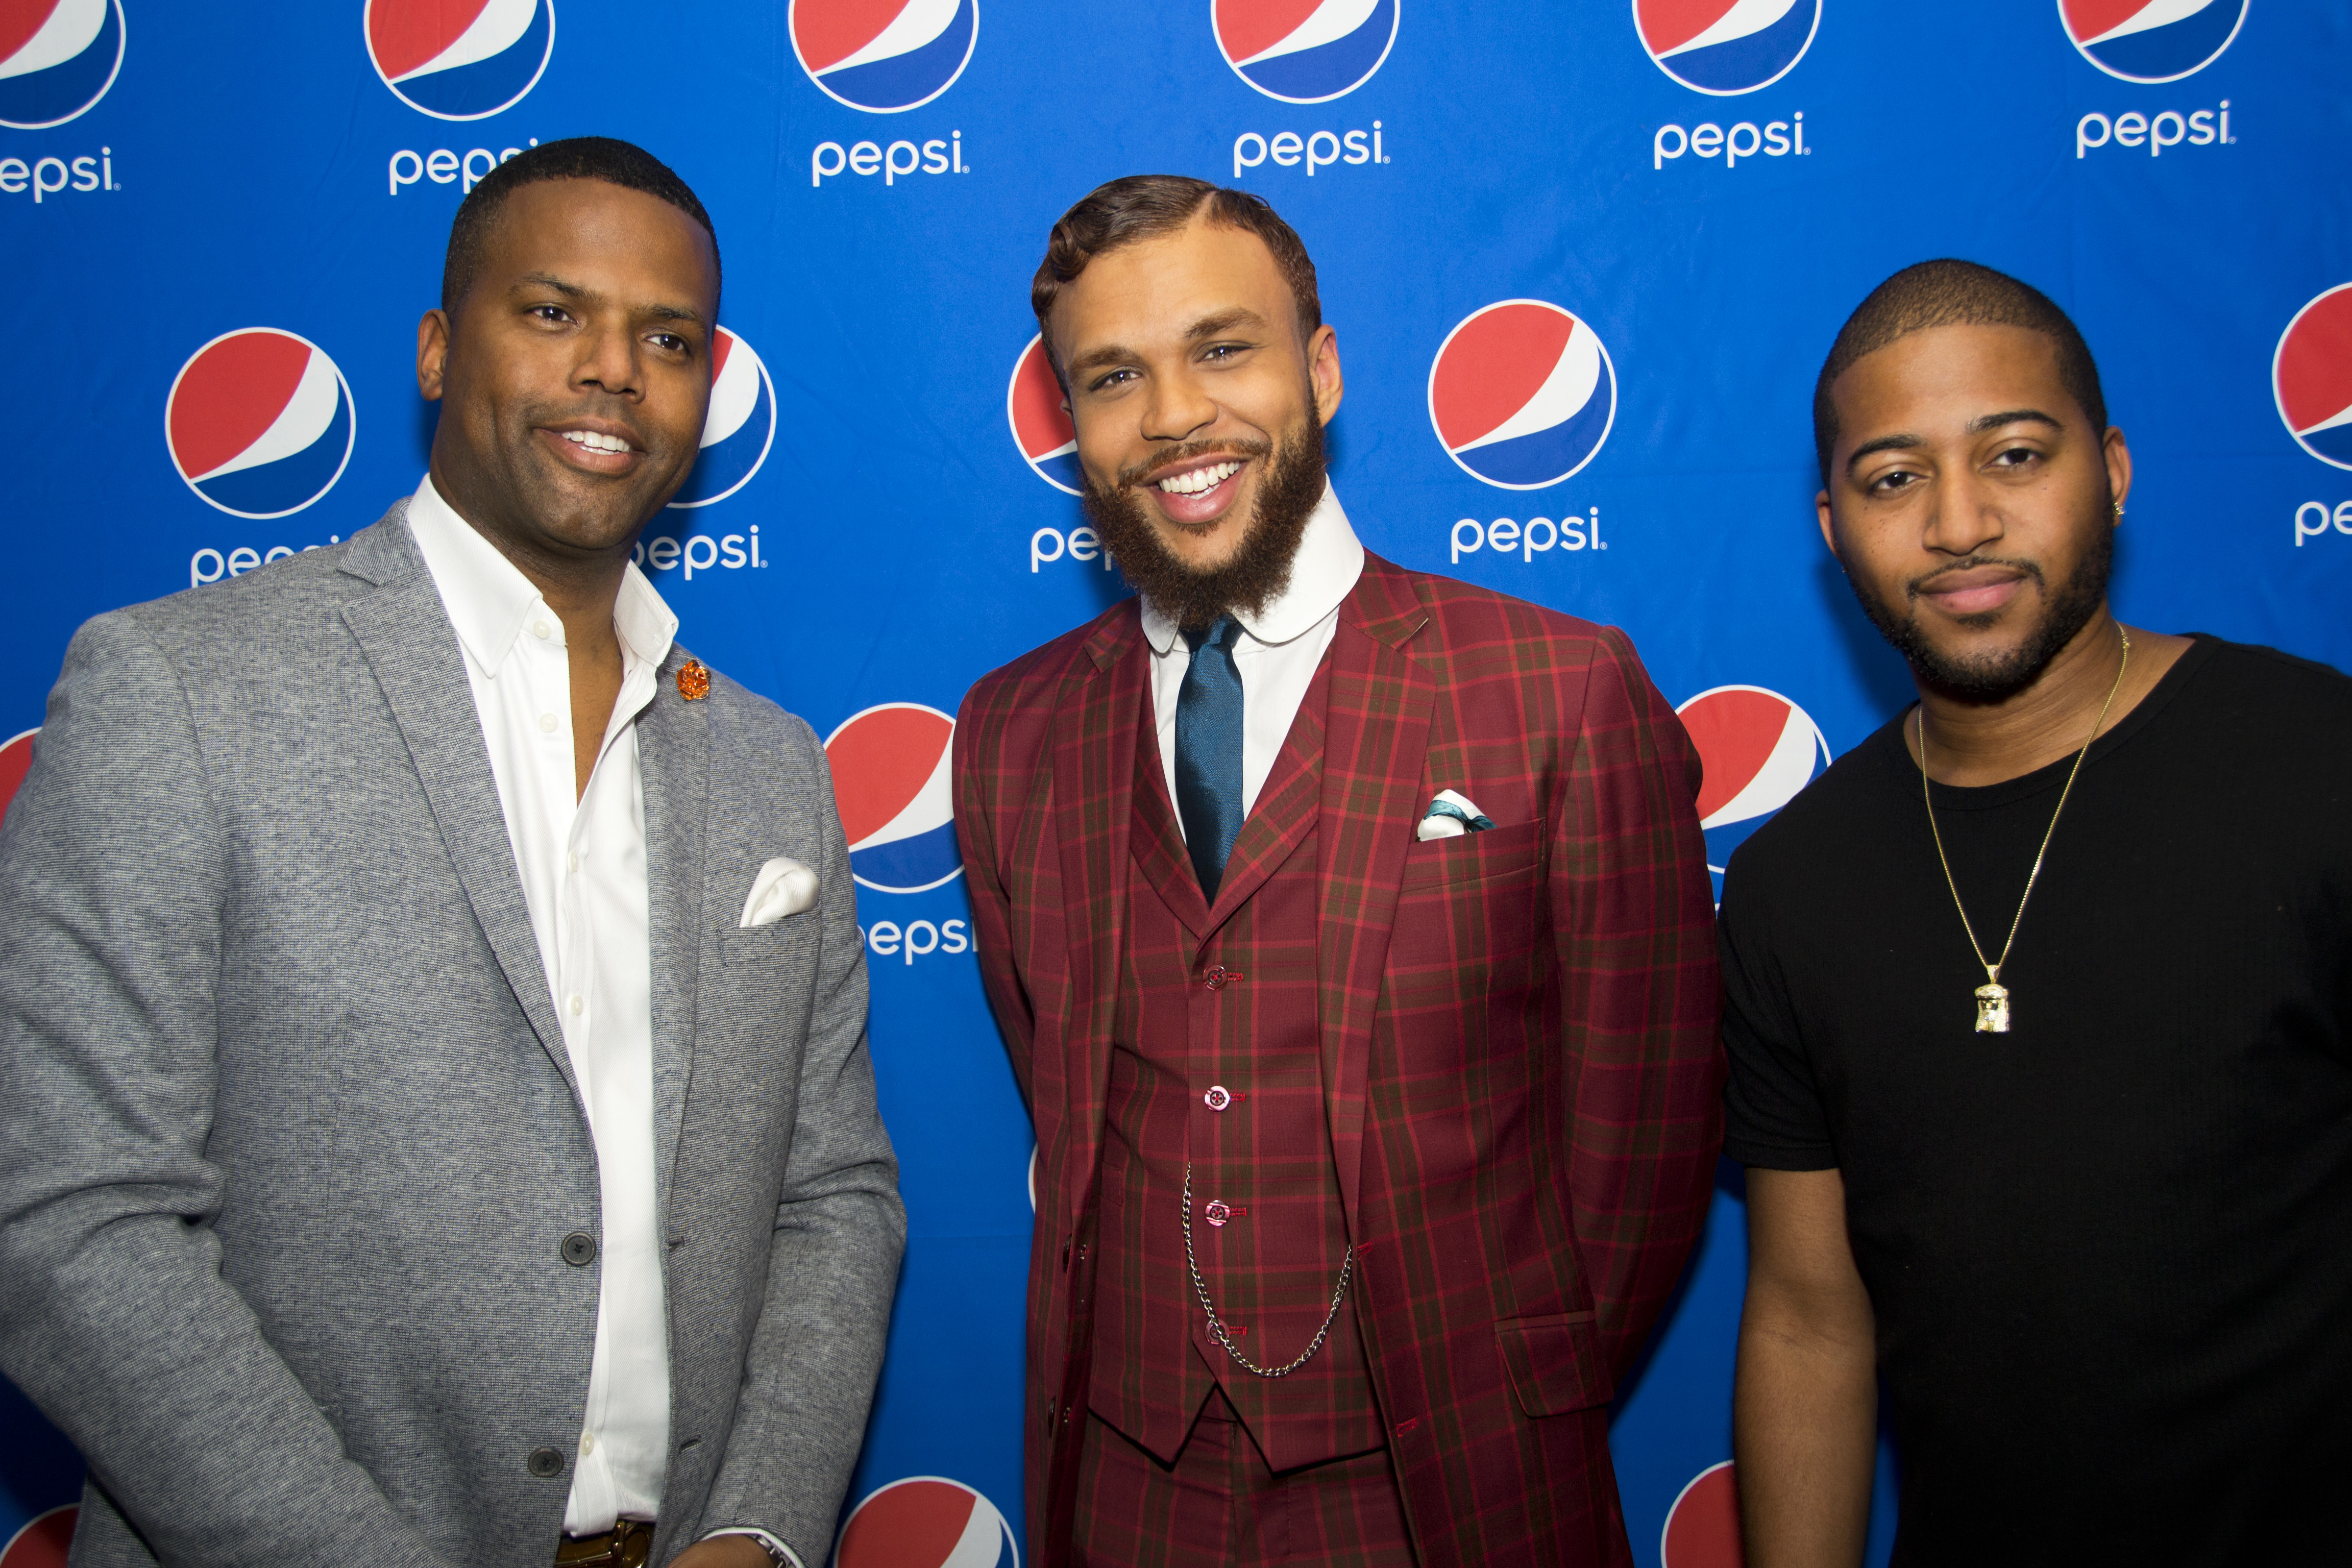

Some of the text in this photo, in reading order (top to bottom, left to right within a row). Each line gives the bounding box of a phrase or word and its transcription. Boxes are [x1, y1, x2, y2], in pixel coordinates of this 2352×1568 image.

[1234, 120, 1382, 178] pepsi
[1654, 111, 1803, 169] pepsi
[2077, 100, 2230, 158] pepsi
[389, 137, 538, 195] pep
[812, 130, 961, 187] pepsi
[633, 524, 759, 580] epsi
[1451, 506, 1599, 564] pepsi
[857, 918, 978, 965] eps
